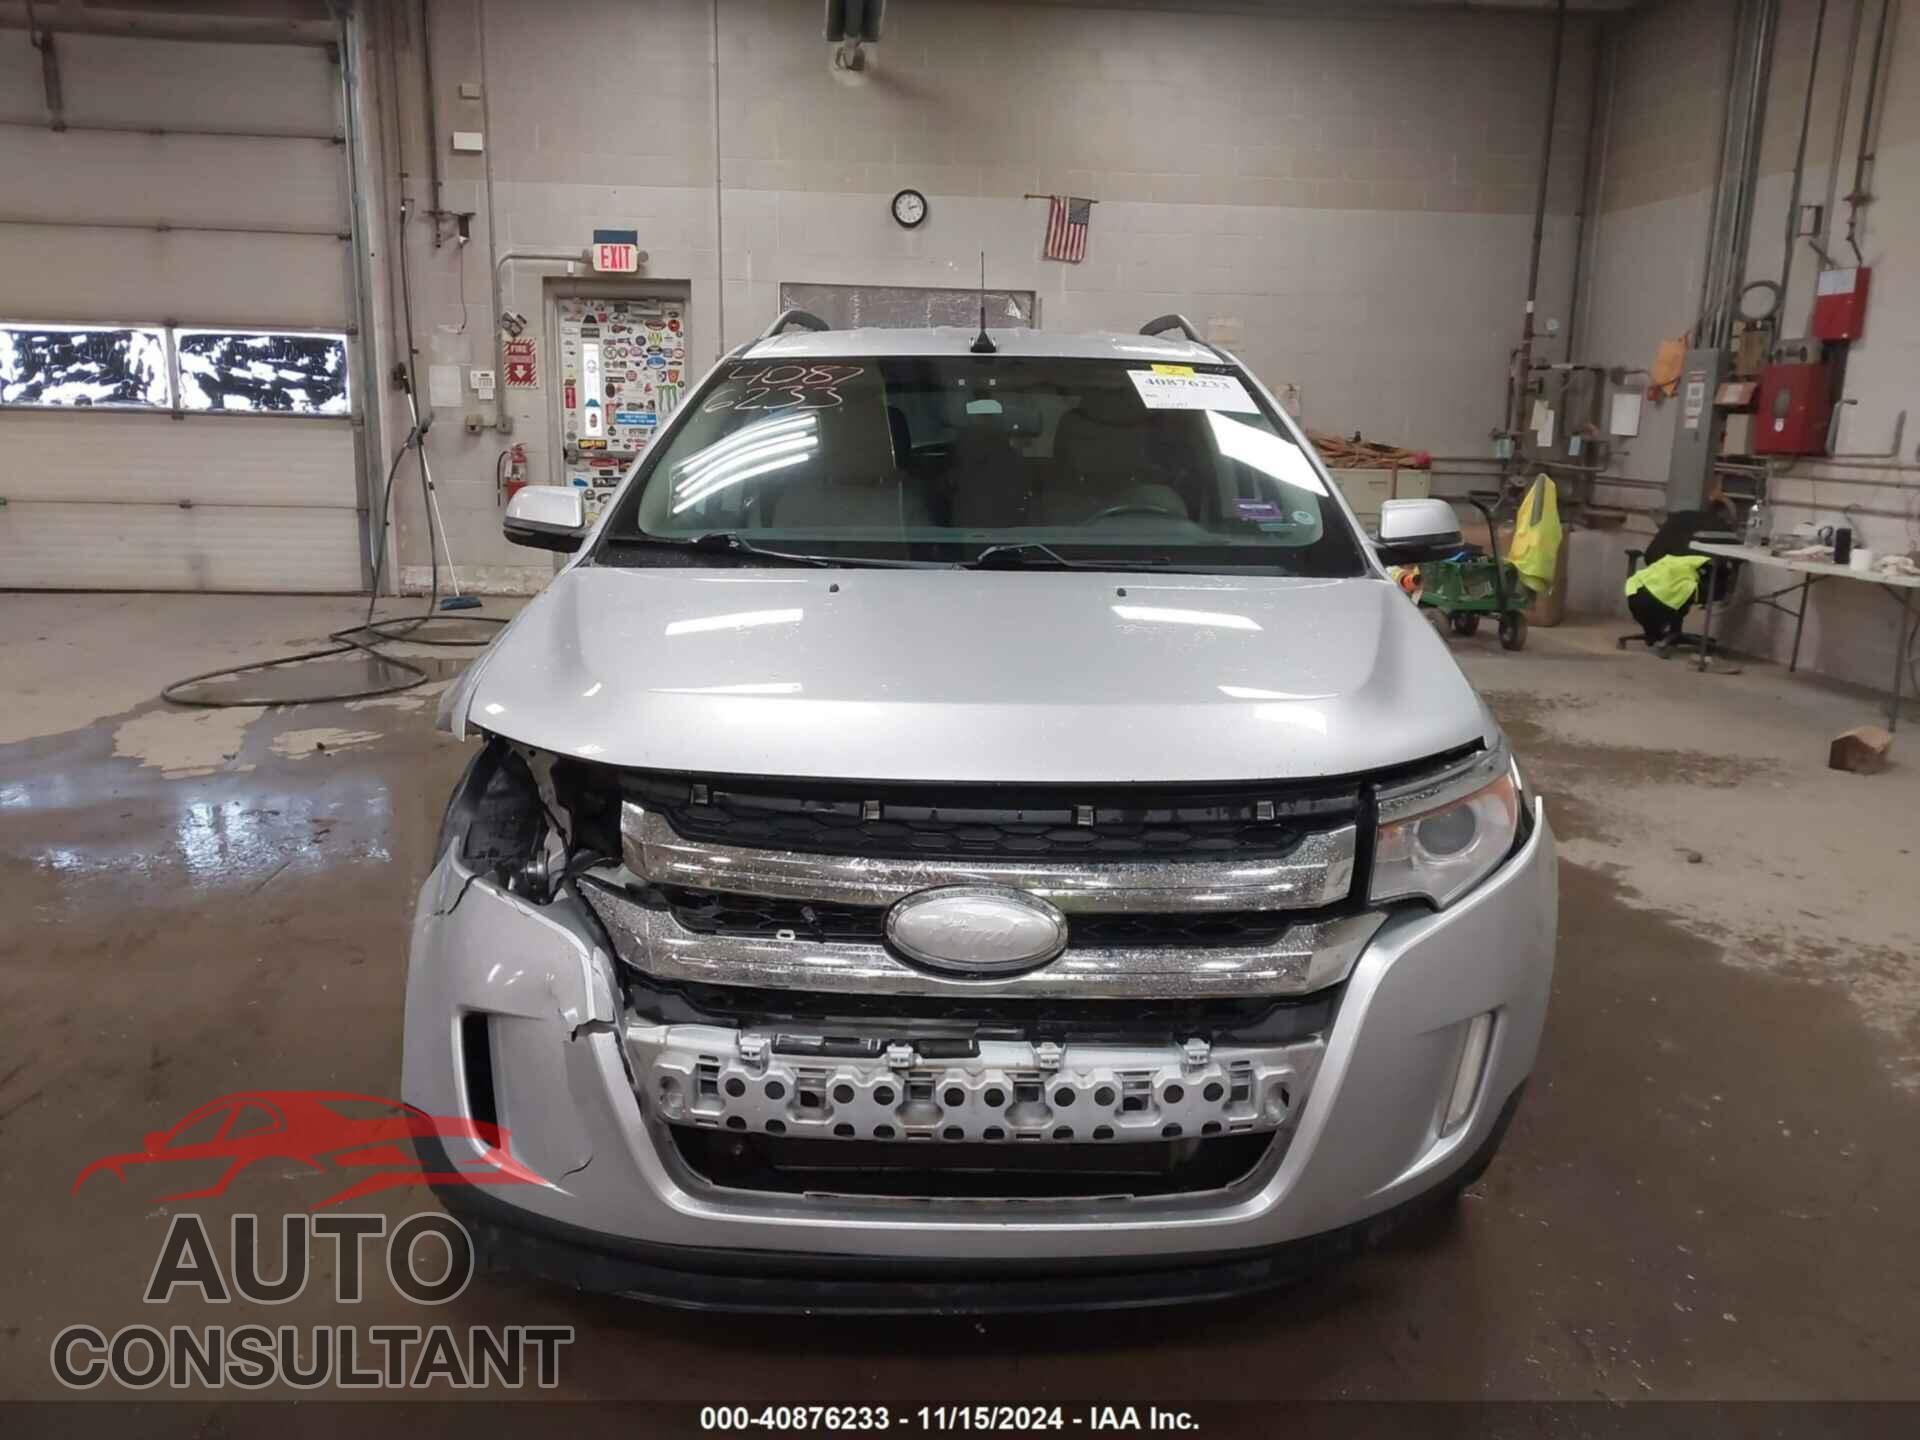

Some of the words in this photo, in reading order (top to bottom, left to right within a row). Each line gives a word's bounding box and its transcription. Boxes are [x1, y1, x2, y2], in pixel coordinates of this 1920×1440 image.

[600, 245, 631, 270] EXIT
[728, 365, 865, 386] 4087
[1144, 377, 1231, 390] 40876233
[702, 386, 843, 413] 6233
